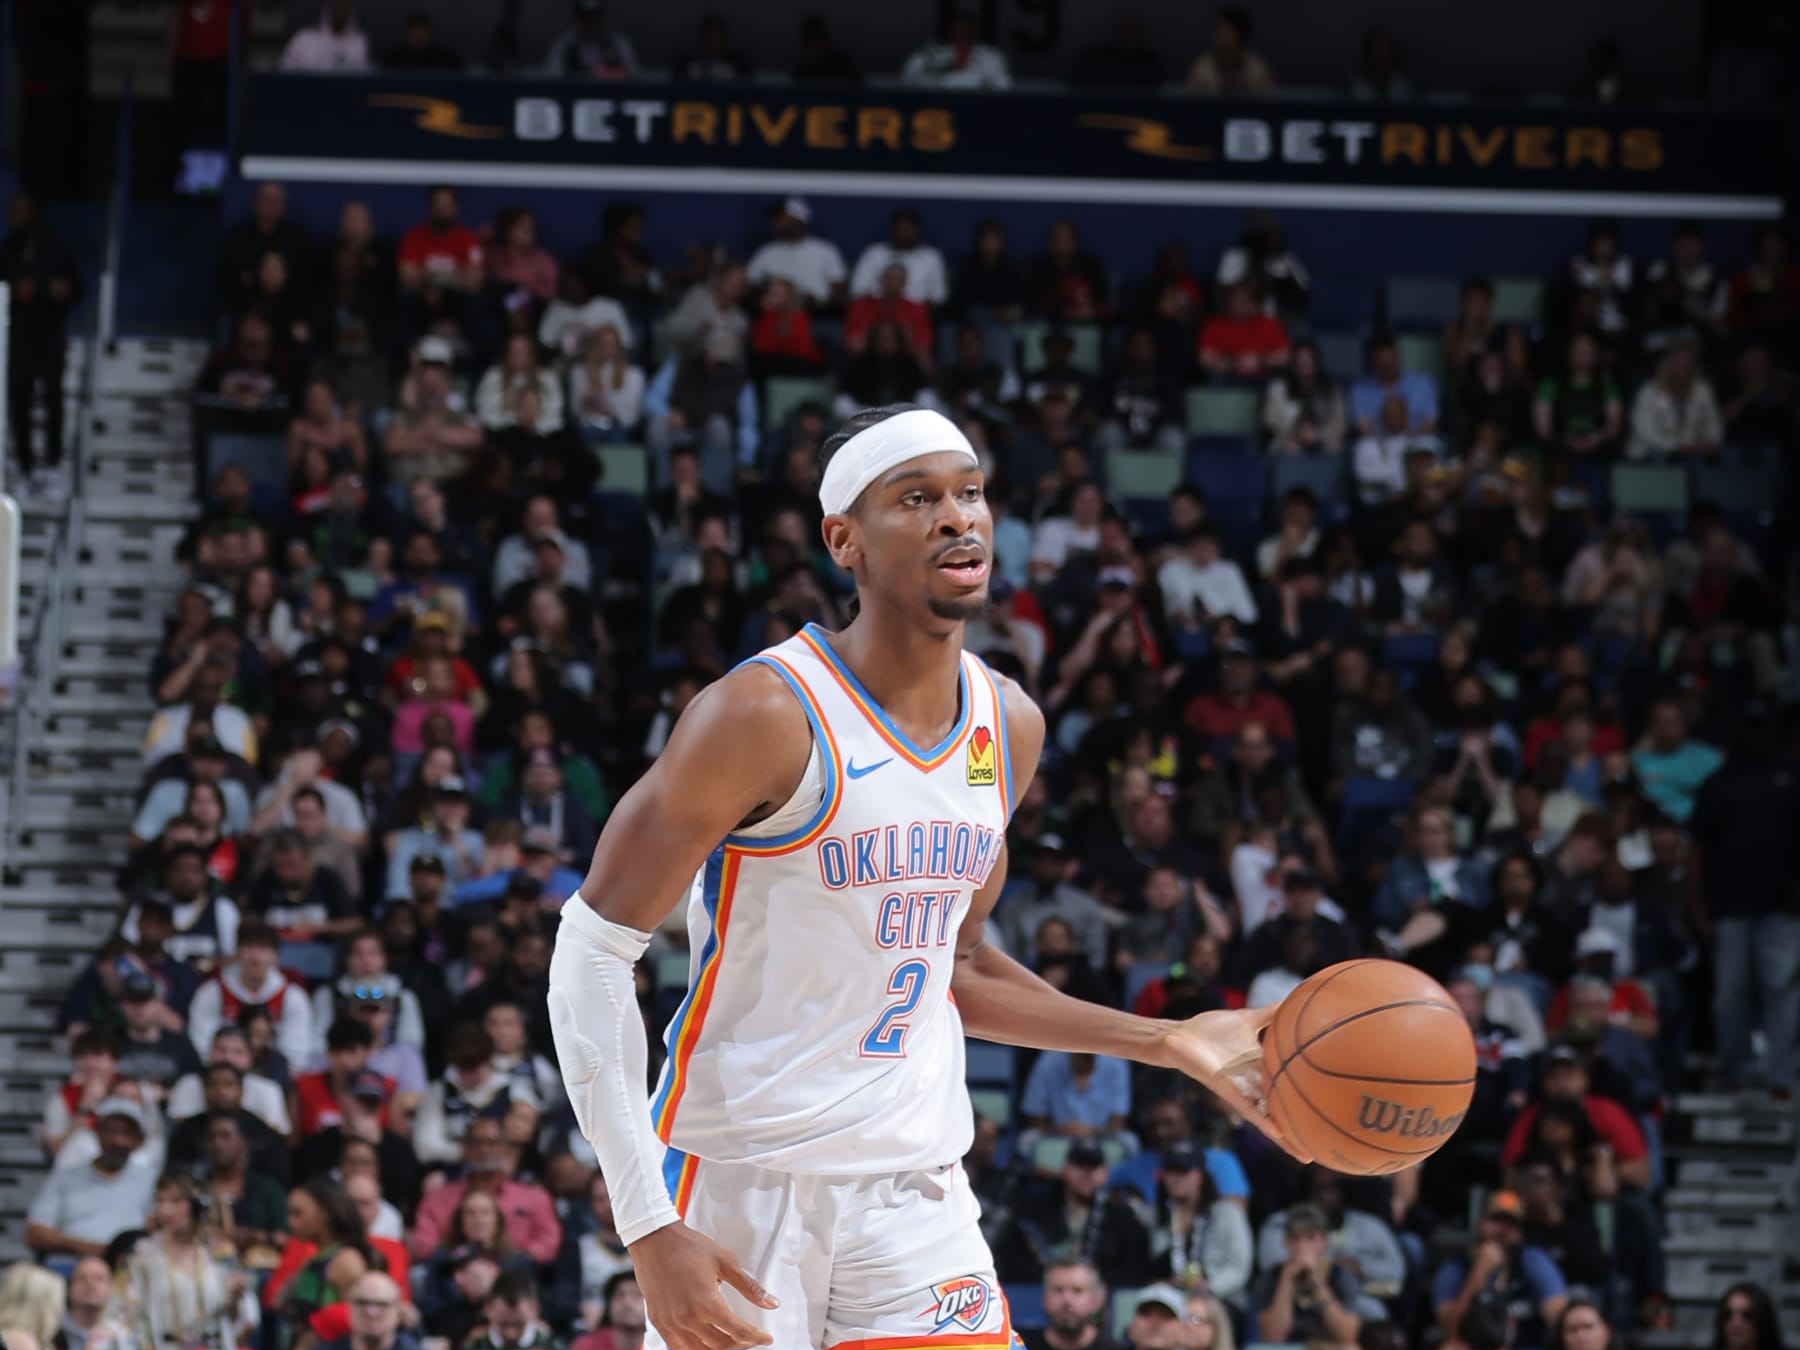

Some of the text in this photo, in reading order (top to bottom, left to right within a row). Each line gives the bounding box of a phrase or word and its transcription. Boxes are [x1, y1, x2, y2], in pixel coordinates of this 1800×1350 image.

[514, 98, 955, 152] BETRIVERS
[1224, 118, 1665, 171] BETRIVERS
[875, 890, 961, 949] CITY
[859, 957, 930, 1059] 2
[936, 1286, 980, 1323] OKC
